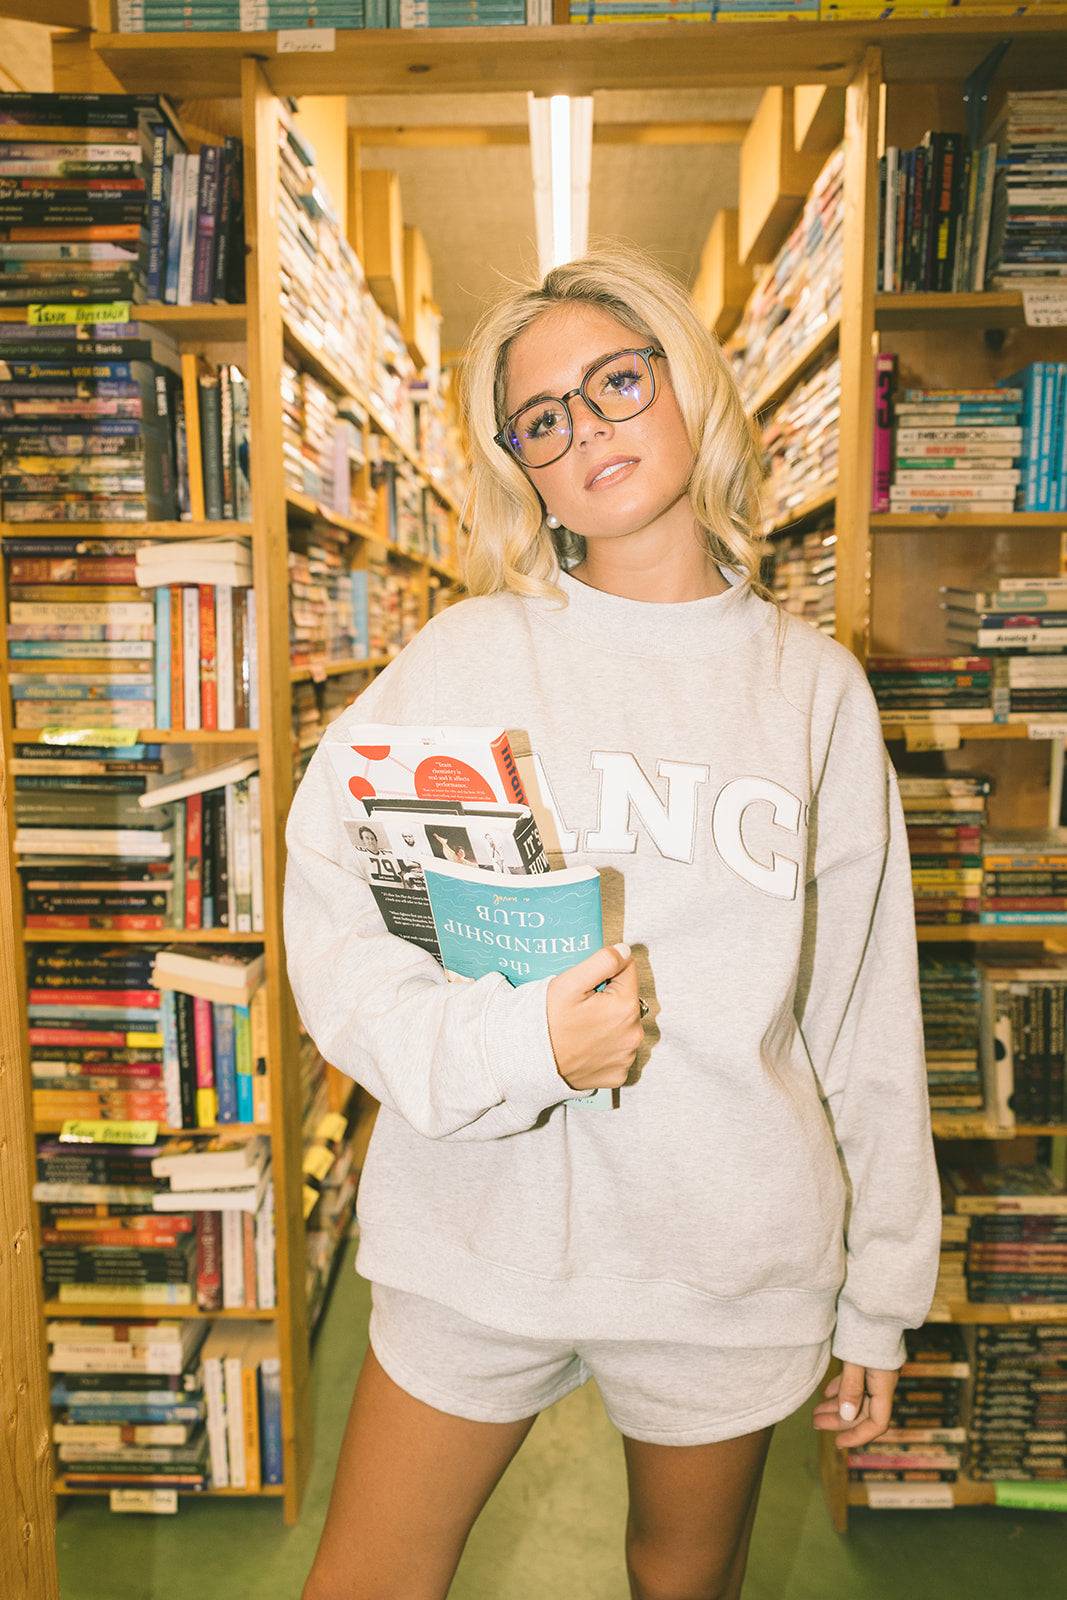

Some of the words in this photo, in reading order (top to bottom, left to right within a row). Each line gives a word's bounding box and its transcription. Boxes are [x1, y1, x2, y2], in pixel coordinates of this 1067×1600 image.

[501, 743, 528, 806] intan
[370, 857, 397, 876] 79
[492, 893, 518, 905] novel
[475, 905, 545, 928] CLUB
[443, 918, 591, 955] FRIENDSHIP
[497, 956, 530, 976] the
